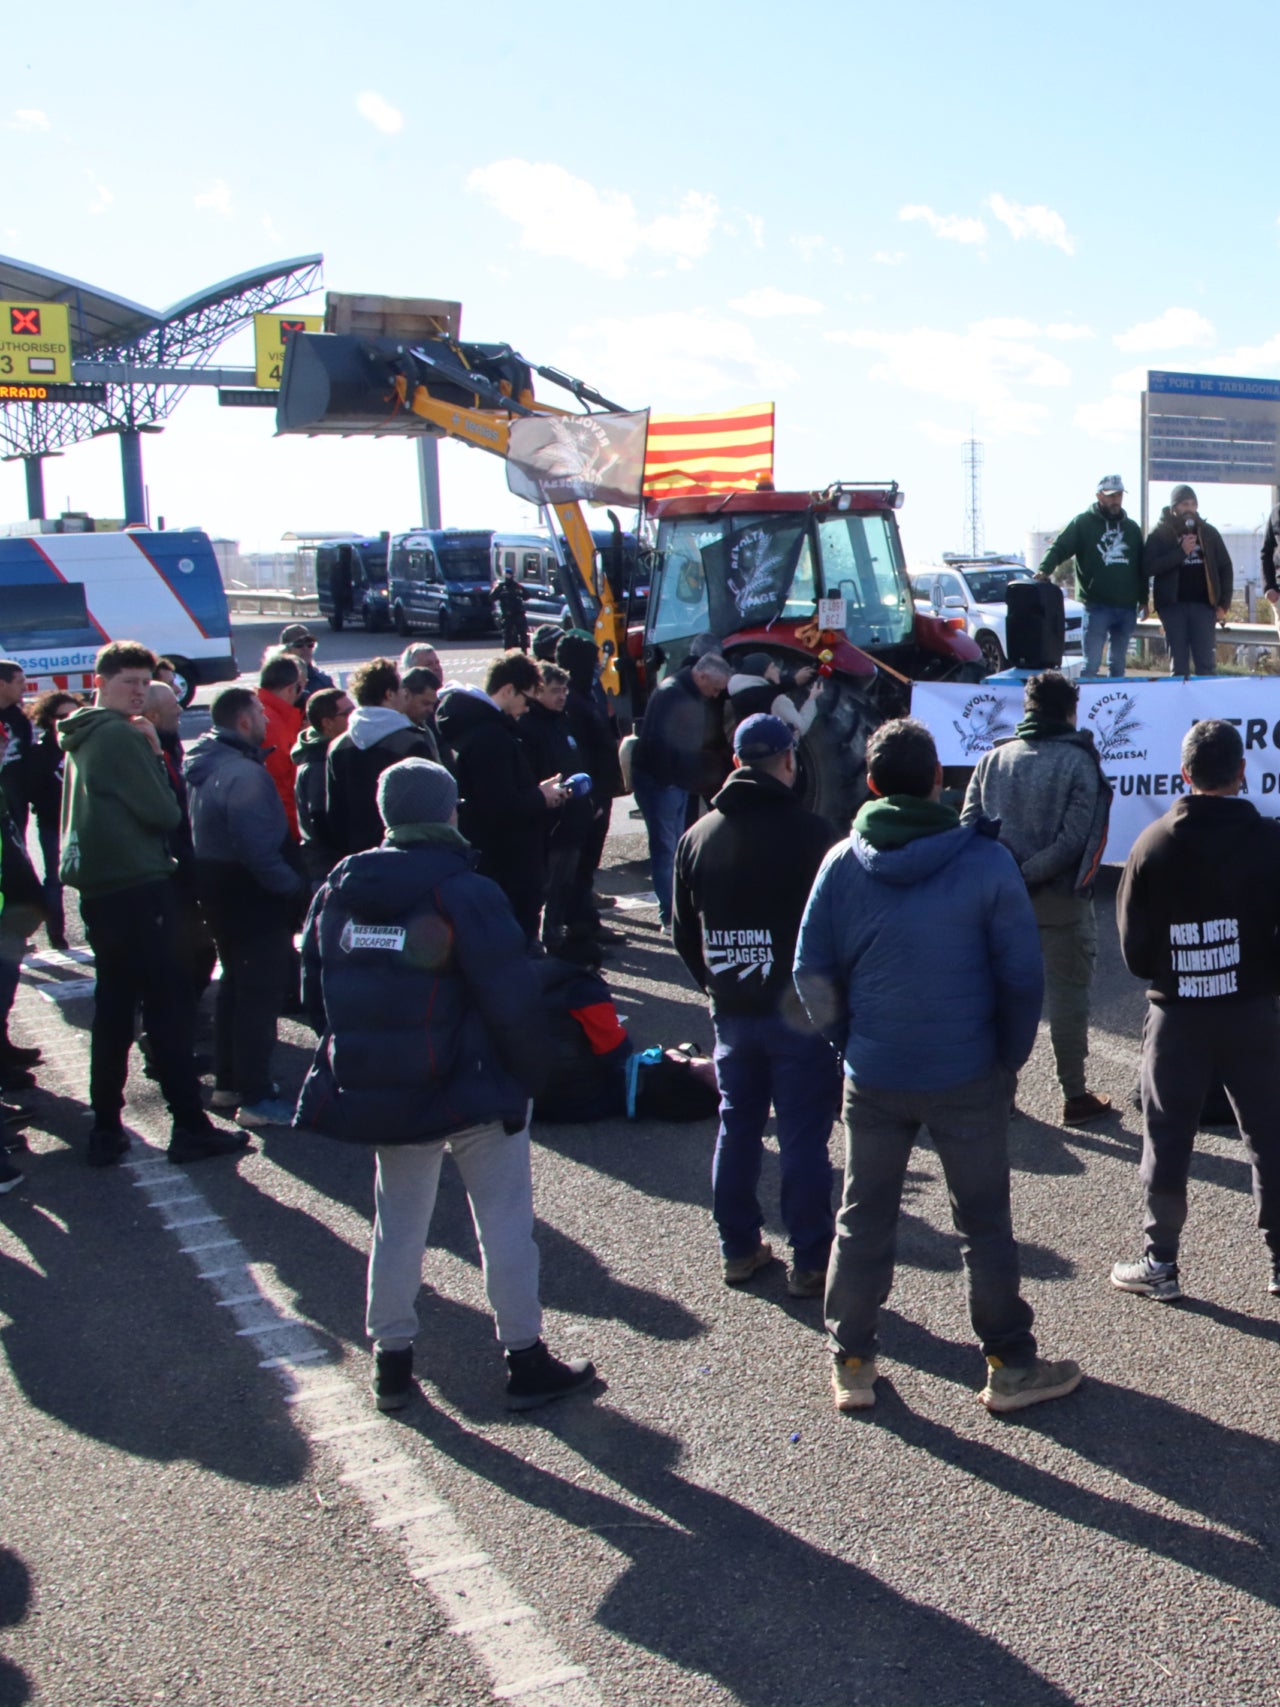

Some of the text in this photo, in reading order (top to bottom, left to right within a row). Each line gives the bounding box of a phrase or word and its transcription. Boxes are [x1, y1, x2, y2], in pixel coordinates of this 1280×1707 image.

[962, 694, 997, 719] REVOLTA
[1088, 692, 1129, 720] REVOLTA
[704, 929, 772, 946] PLATAFORMA
[1170, 918, 1238, 945] PREUS JUSTOS
[726, 947, 774, 963] PAGESA
[1178, 970, 1238, 997] SOSTENIBLE
